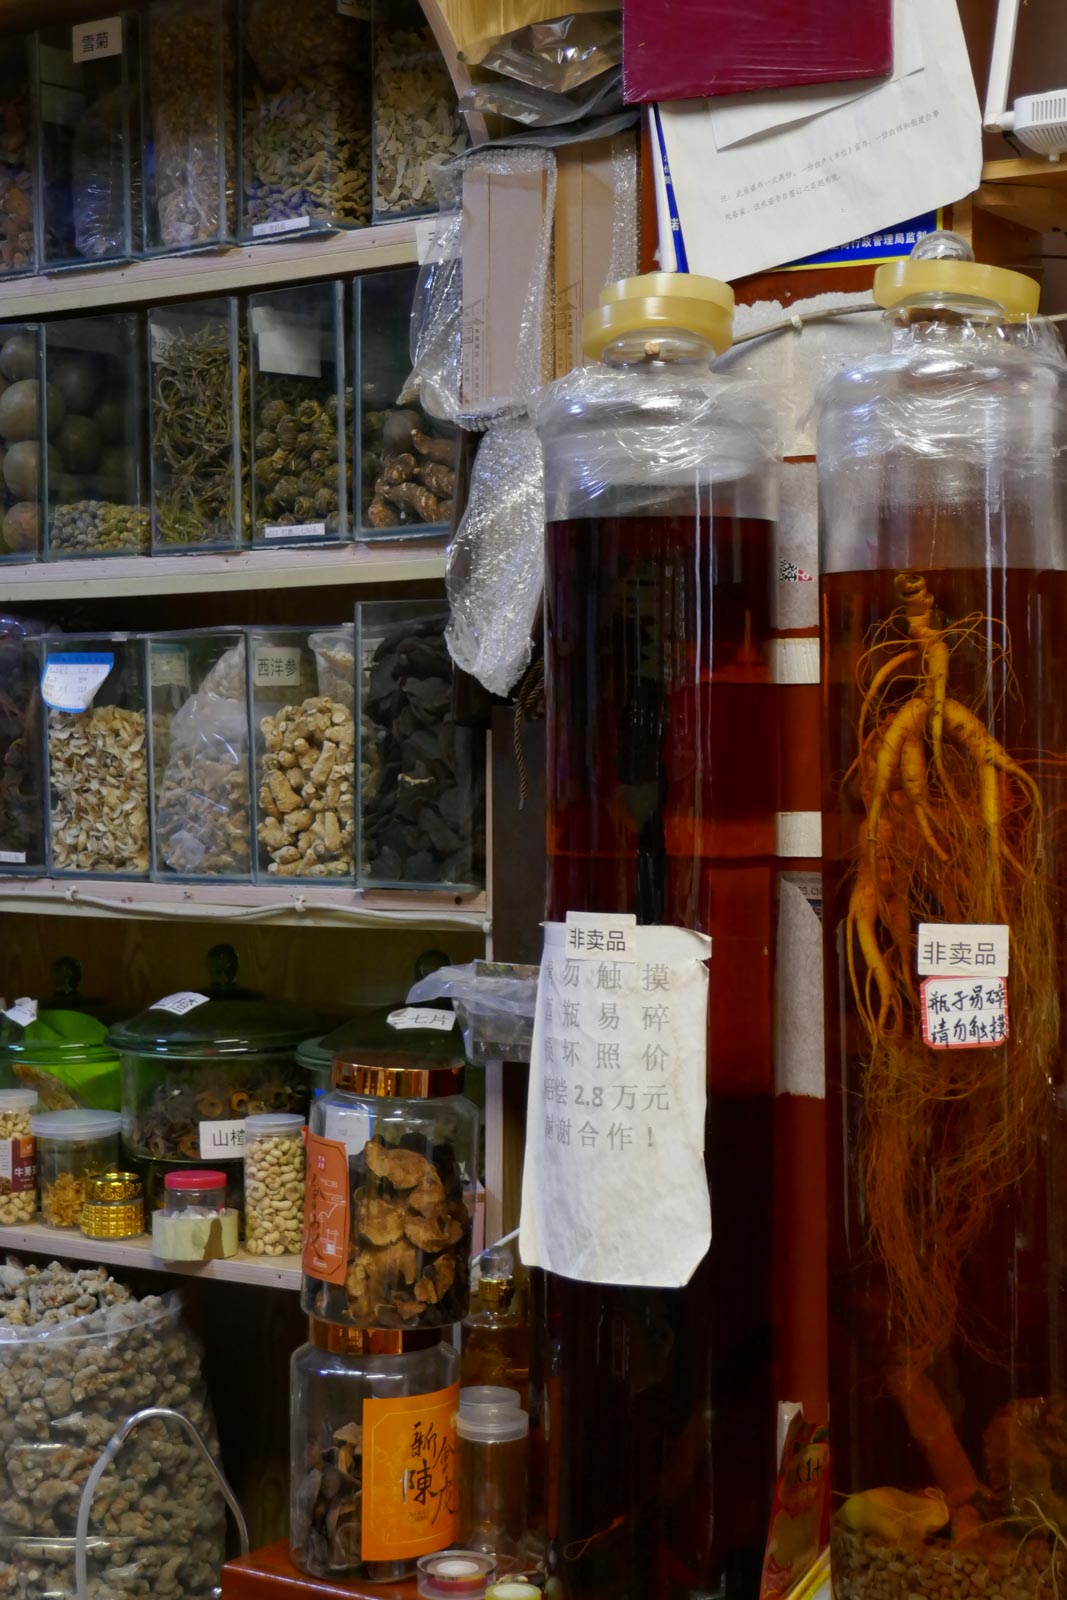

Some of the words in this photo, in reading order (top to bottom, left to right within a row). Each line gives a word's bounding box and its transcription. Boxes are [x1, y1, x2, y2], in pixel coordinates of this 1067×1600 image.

[82, 31, 109, 53] 雪菊
[257, 657, 297, 677] 西洋参
[569, 928, 626, 952] 非卖品
[922, 941, 996, 966] 非卖品
[928, 984, 1005, 1015] 瓶子易碎
[931, 1015, 1008, 1048] 请勿触摸
[213, 1129, 246, 1147] 山楂
